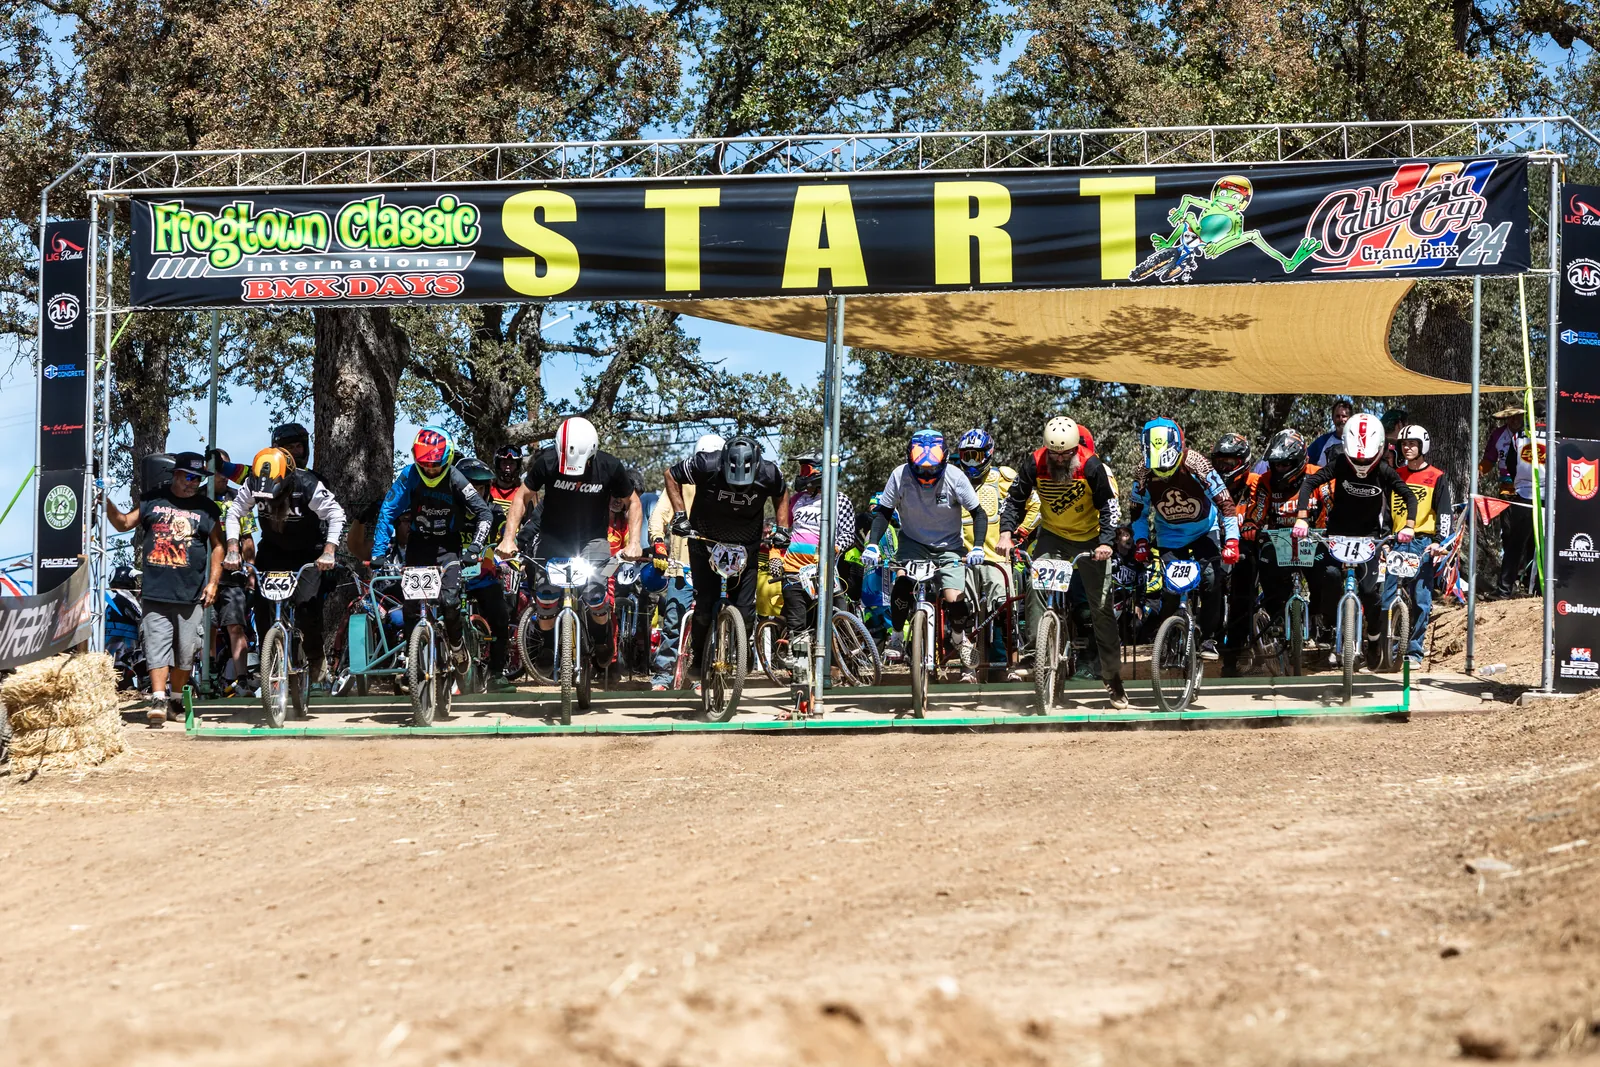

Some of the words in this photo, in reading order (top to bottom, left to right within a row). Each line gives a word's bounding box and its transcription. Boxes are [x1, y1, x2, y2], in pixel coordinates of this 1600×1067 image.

[1306, 177, 1475, 263] California
[1408, 188, 1486, 237] Cup
[1564, 214, 1581, 224] LIG
[148, 200, 332, 269] Frogtown
[335, 194, 481, 250] Classic
[500, 176, 1156, 297] START
[45, 253, 60, 262] LIG
[1361, 244, 1416, 261] Grand
[1419, 242, 1460, 259] Prix
[247, 255, 462, 272] international
[244, 277, 341, 300] BMX
[346, 274, 463, 297] DAYS
[579, 483, 603, 493] COMP
[717, 489, 758, 506] FLY
[793, 510, 821, 524] BMX
[1164, 504, 1195, 516] RACING
[1344, 541, 1360, 560] 14
[1558, 550, 1578, 558] BEAR
[1579, 551, 1600, 559] VALLE
[623, 569, 635, 582] 48
[1037, 567, 1066, 584] 274
[1171, 565, 1192, 578] 239
[264, 578, 290, 591] 666
[409, 572, 434, 592] 32
